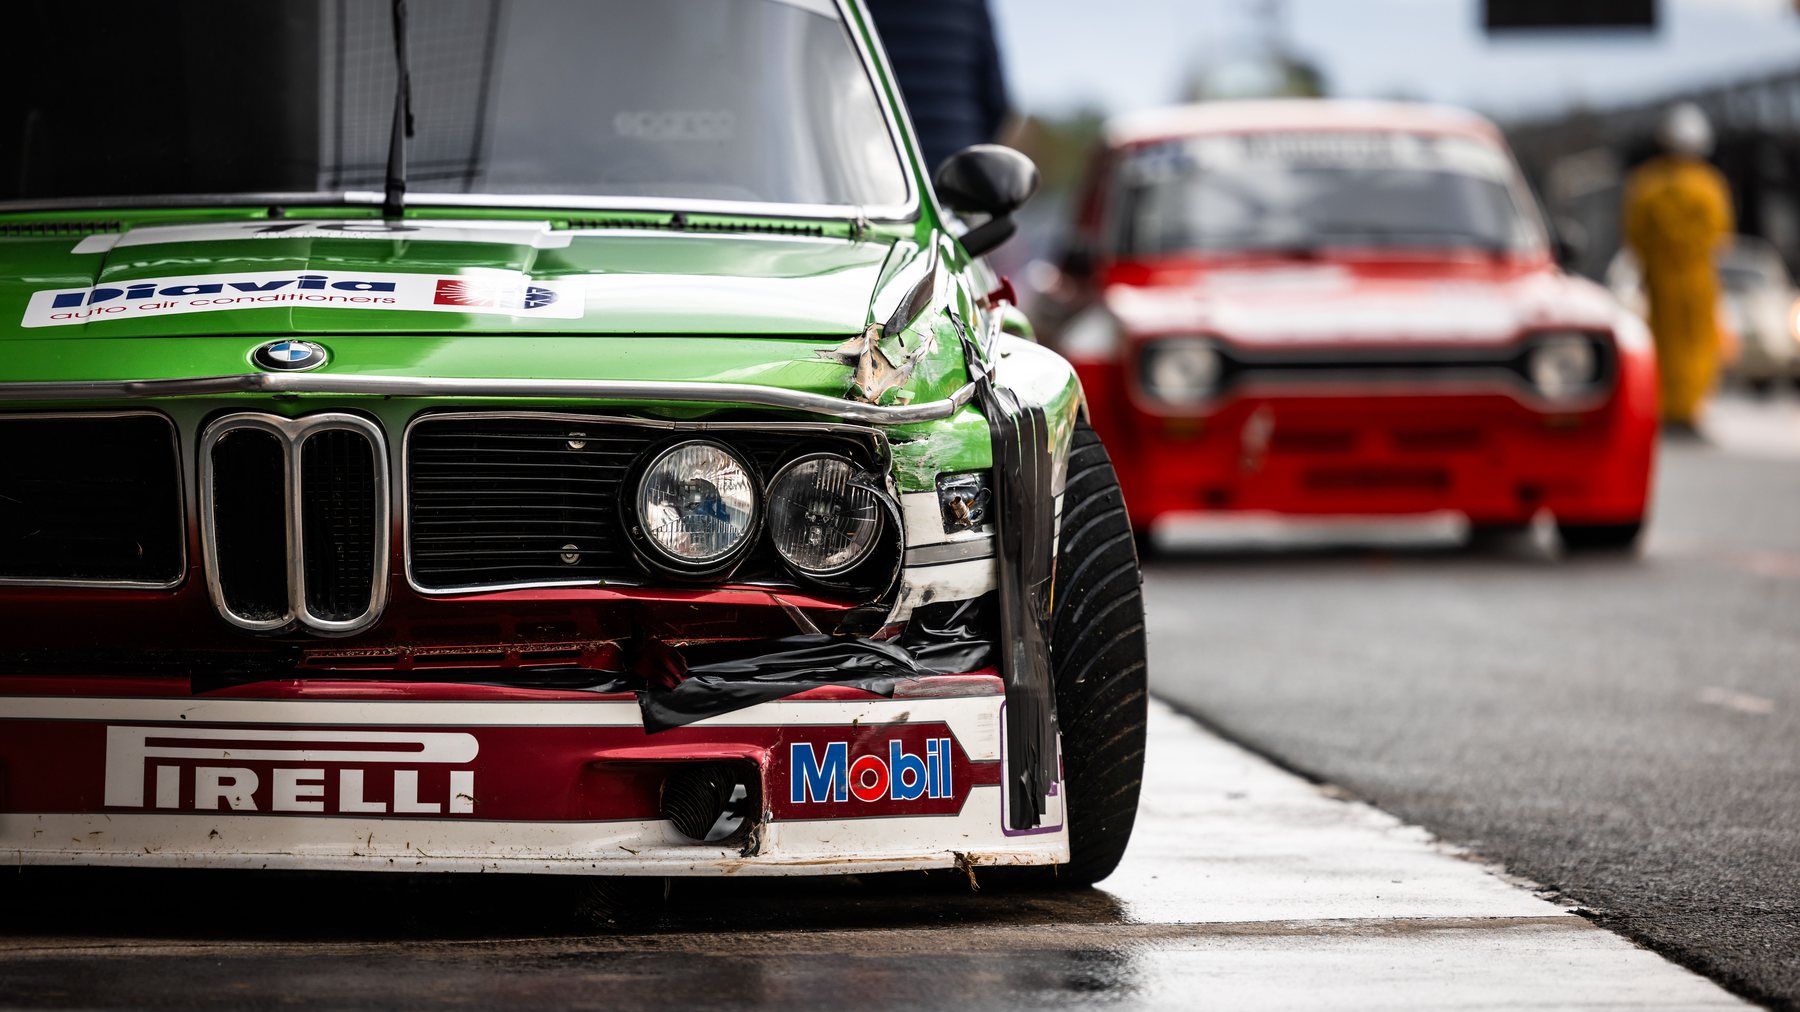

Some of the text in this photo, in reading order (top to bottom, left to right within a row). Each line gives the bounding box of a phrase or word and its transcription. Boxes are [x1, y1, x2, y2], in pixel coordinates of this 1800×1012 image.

[50, 293, 396, 320] auto air conditioners
[52, 275, 396, 308] Diavia
[104, 725, 479, 814] PIRELLI
[790, 737, 953, 804] Mobil
